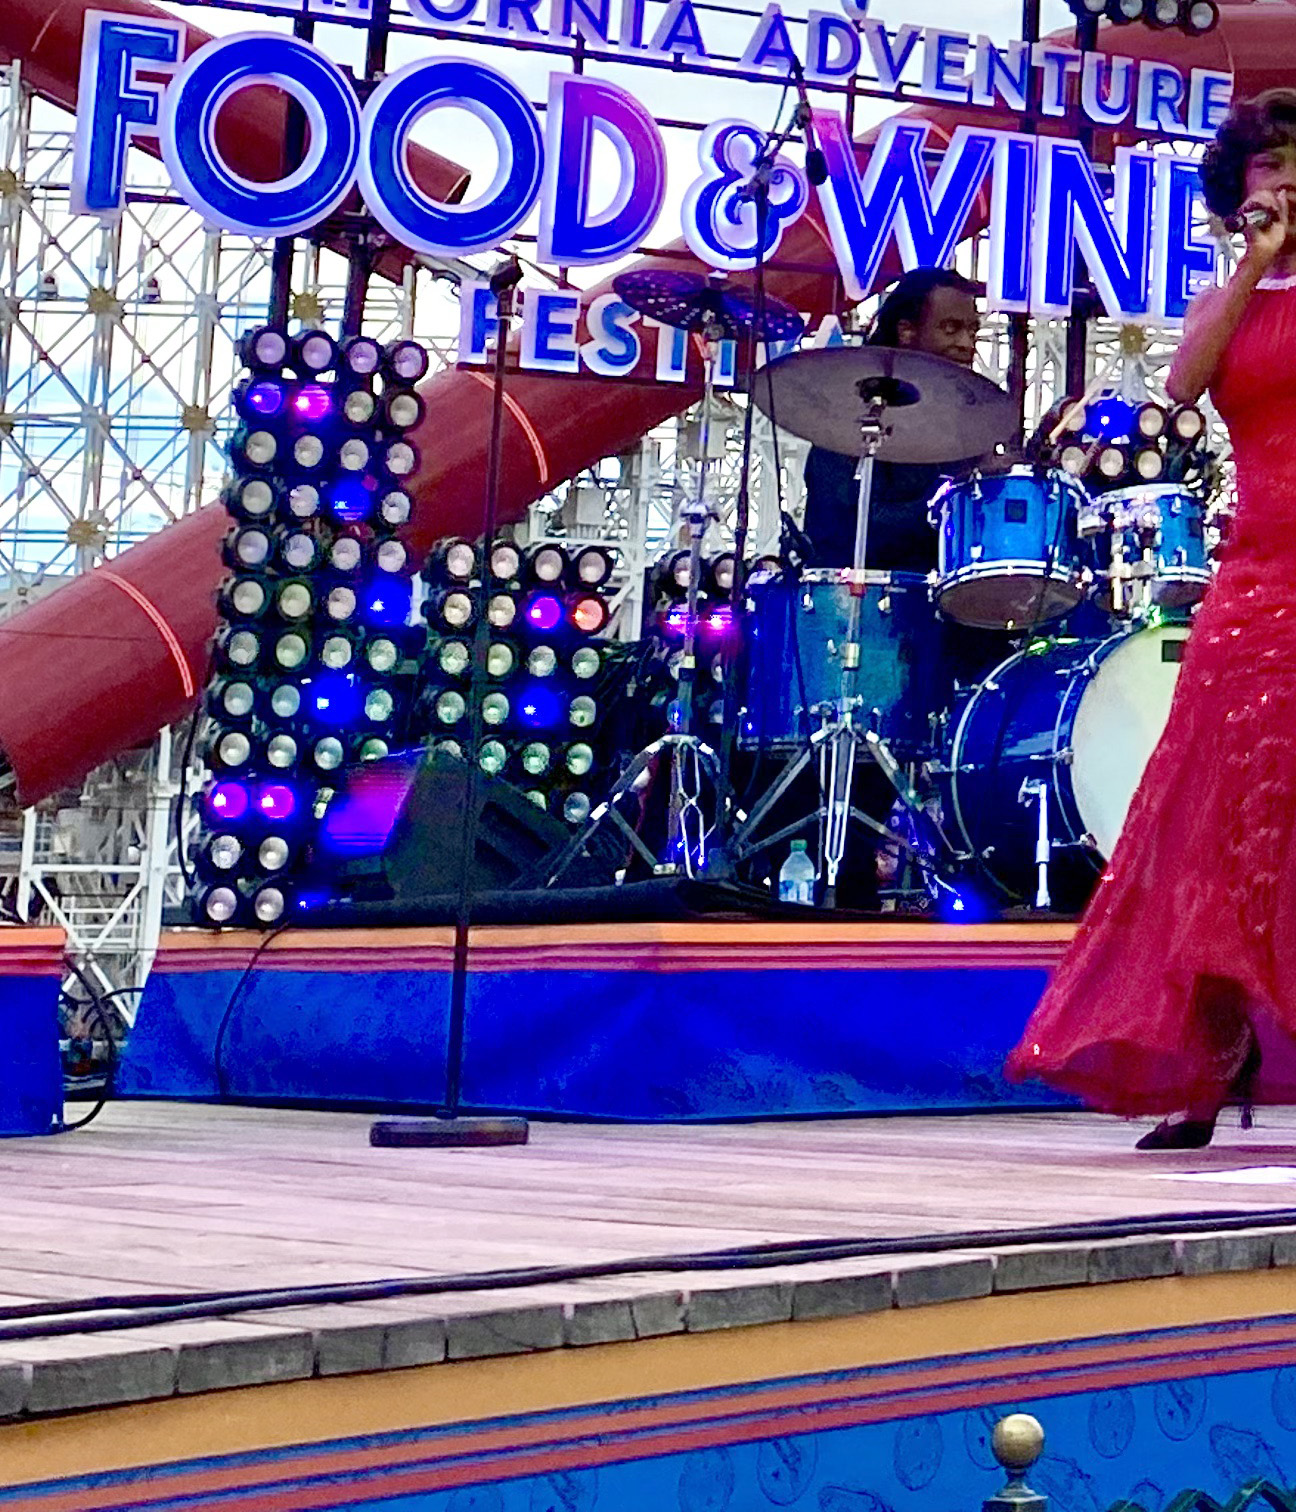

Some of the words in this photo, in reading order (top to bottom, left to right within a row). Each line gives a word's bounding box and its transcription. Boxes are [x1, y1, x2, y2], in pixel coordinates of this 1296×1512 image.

[69, 9, 668, 266] FOOD
[680, 117, 809, 270] &
[810, 107, 1218, 326] WINE
[735, 2, 1234, 139] ADVENTURE
